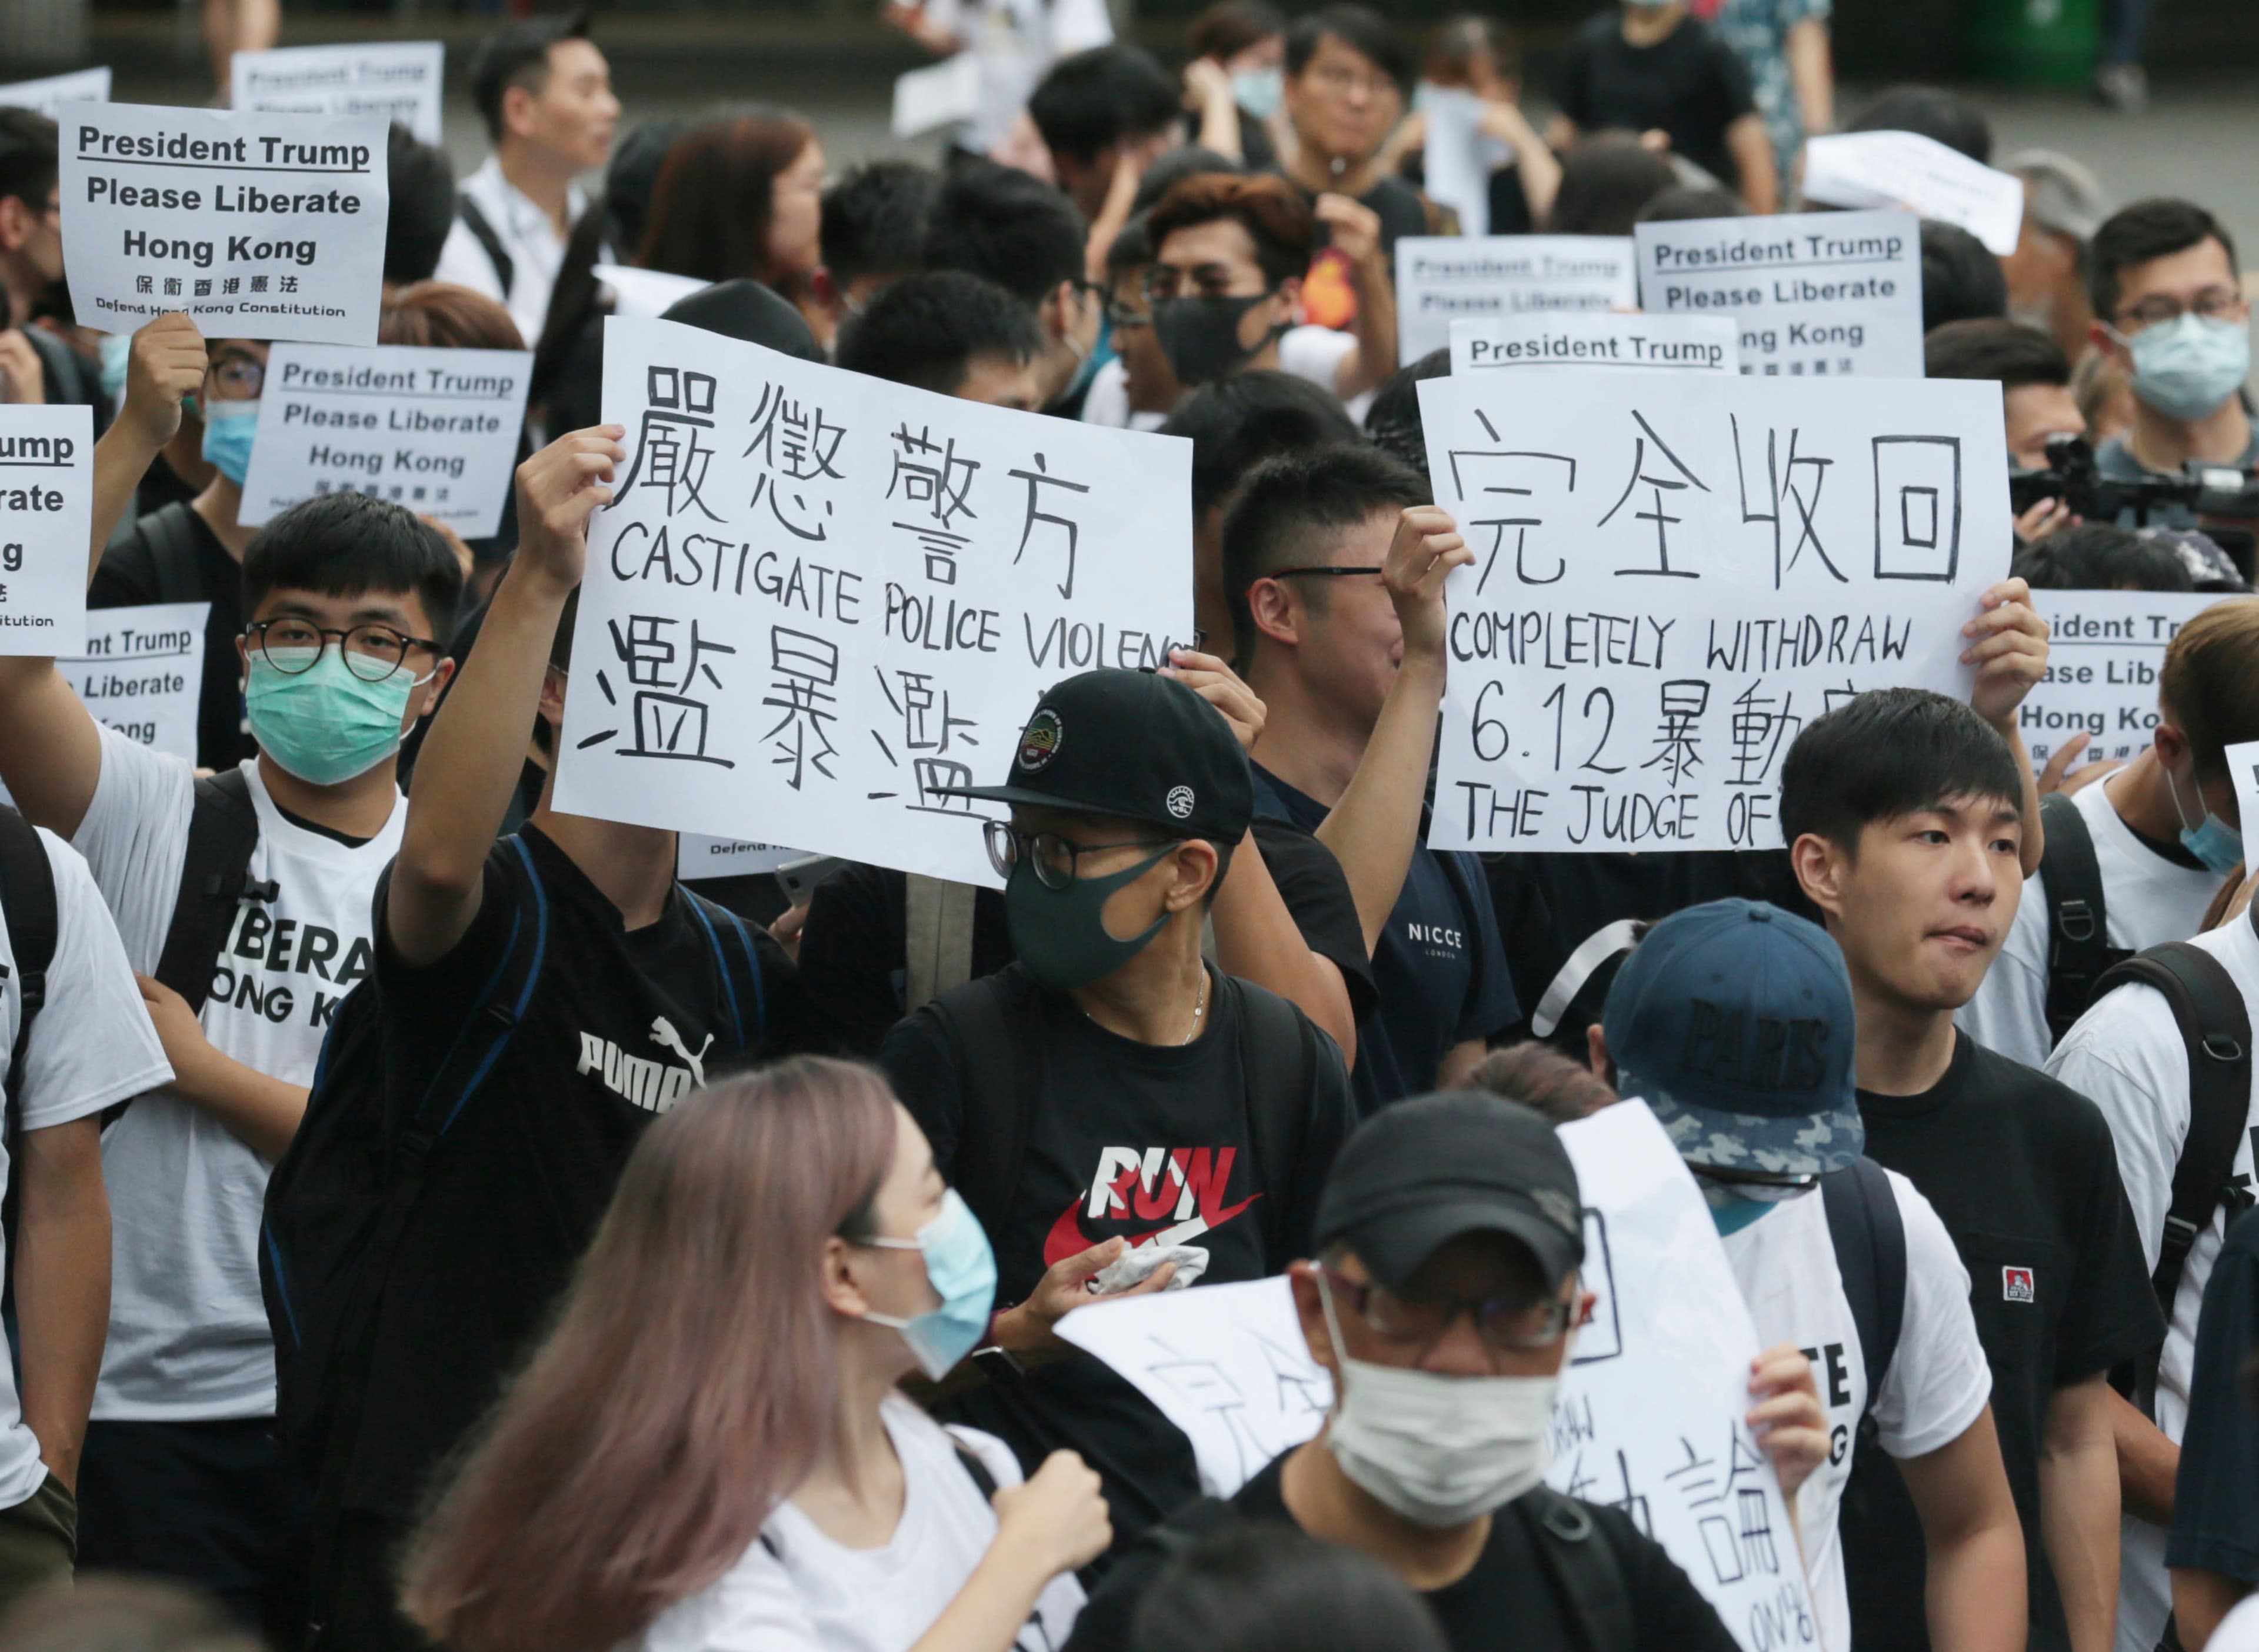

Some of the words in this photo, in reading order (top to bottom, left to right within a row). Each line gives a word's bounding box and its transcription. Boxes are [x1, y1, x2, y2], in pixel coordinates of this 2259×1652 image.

[78, 126, 247, 162] President
[259, 136, 369, 170] Trump
[87, 176, 201, 209] Please
[215, 185, 361, 214] Liberate
[124, 230, 214, 268] Hong
[228, 236, 316, 266] Kong
[1655, 241, 1795, 267] President
[1807, 236, 1902, 259] Trump
[96, 297, 146, 315] Defend
[194, 303, 234, 315] Kong
[239, 302, 346, 318] Constitution
[1666, 286, 1762, 309] Please
[1774, 276, 1895, 303] Liberate
[1471, 334, 1619, 361] President
[1629, 337, 1722, 368] Trump
[1790, 323, 1864, 348] Kong
[282, 362, 415, 389] President
[428, 369, 514, 398] Trump
[284, 403, 378, 430] Please
[389, 410, 500, 433] Liberate
[309, 444, 383, 475] Hong
[395, 450, 465, 477] Kong
[602, 365, 1091, 600] 嚴懲警方
[1448, 409, 1961, 596] 完全收回
[611, 522, 863, 625] CASTIGATE
[885, 582, 1001, 652] POLICE
[1024, 612, 1196, 670] VIOLEN
[121, 630, 192, 655] Trump
[1450, 610, 1676, 670] COMPLETELY
[1707, 614, 1912, 673] WITHDRAW
[2045, 613, 2135, 639] ident
[84, 672, 185, 699] Liberate
[2106, 660, 2161, 685] Lib
[577, 615, 1047, 822] 濫暴濫
[1471, 678, 1861, 789] 6.12暴動
[2021, 705, 2105, 736] Hong
[1455, 780, 1550, 841] THE
[1567, 785, 1701, 846] JUDGE
[1726, 793, 1773, 847] OF
[1408, 922, 1462, 949] NICCE
[575, 1030, 692, 1115] PUMA
[1087, 1146, 1237, 1224] RUN
